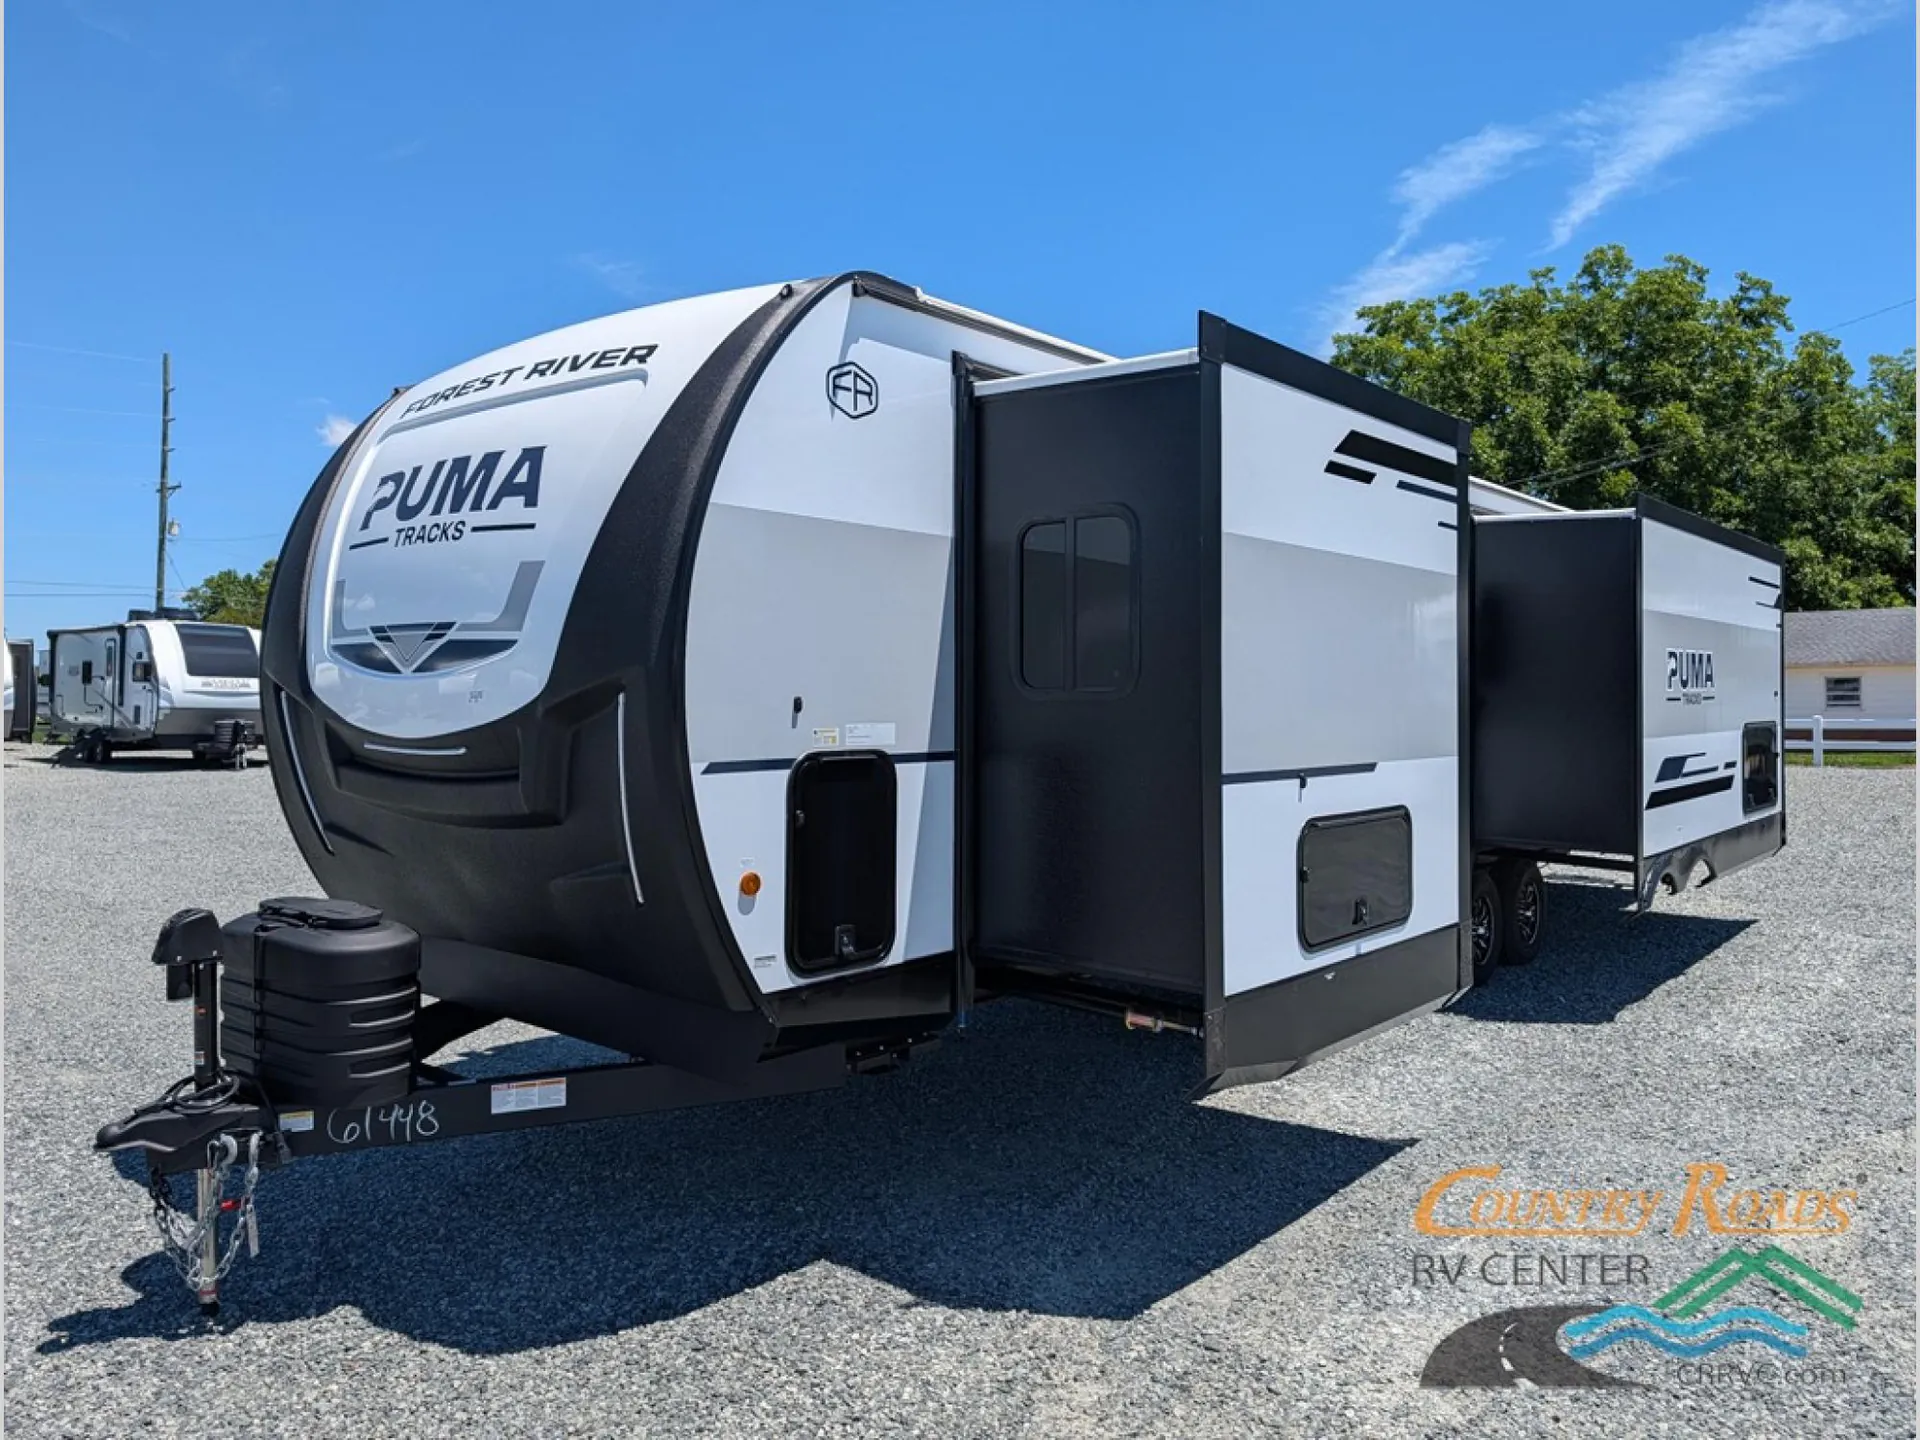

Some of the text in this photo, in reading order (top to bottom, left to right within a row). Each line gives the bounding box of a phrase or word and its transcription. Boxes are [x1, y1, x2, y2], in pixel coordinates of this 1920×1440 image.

[400, 344, 659, 419] FOREST RIVER
[359, 446, 547, 531] PUMA
[394, 520, 466, 548] TRACKS
[1667, 651, 1715, 689] PUMA
[326, 1100, 439, 1144] 61448
